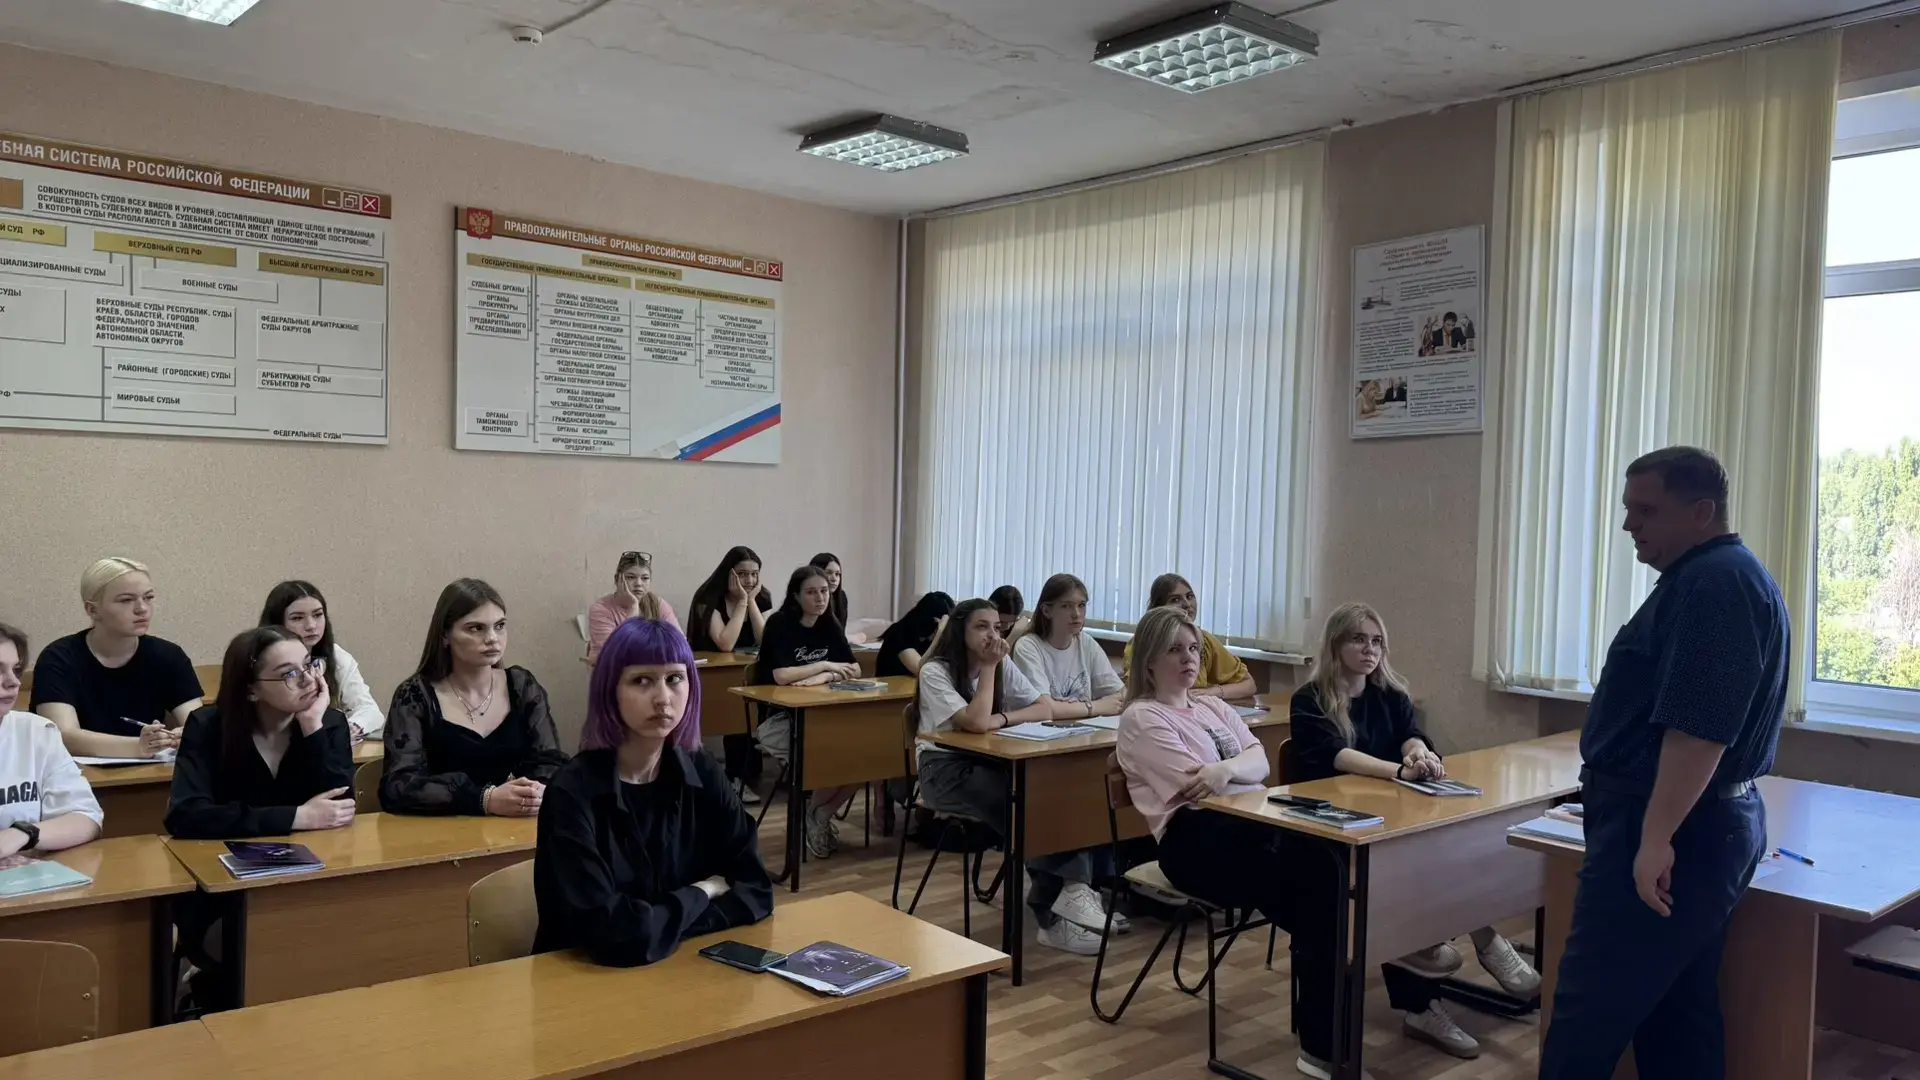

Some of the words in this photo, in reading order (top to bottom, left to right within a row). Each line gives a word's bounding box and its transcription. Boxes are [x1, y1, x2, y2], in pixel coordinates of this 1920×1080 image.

[0, 140, 44, 159] БНАЯ
[50, 148, 121, 170] СИСТЕМА
[127, 160, 223, 187] РОССИЙСКОЙ
[229, 176, 310, 200] ФЕДЕРАЦИИ
[37, 185, 99, 200] СОВОКУПНОСТЬ
[101, 194, 126, 204] СУДОВ
[128, 198, 147, 207] ВСЕХ
[148, 201, 173, 211] ВИДОВ
[175, 204, 180, 212] И
[217, 211, 274, 225] СОСТАВЛЯЮЩАЯ
[277, 220, 303, 230] ЕДИНОЕ
[304, 223, 325, 233] ЦЕЛОЕ
[333, 227, 375, 239] ПРИЗВАННАЯ
[37, 194, 99, 209] ОСУЩЕСТВЛЯТЬ
[101, 203, 142, 215] СУДЕБНУЮ
[175, 213, 212, 225] СУДЕБНАЯ
[214, 218, 246, 229] СИСТЕМА
[247, 223, 270, 232] ИМЕЕТ
[273, 227, 327, 240] ИЕРАРХИЧЕСКОЕ
[38, 202, 43, 210] В
[45, 203, 82, 214] КОТОРОЙ
[83, 209, 106, 218] СУДЫ
[107, 212, 170, 227] РАСПОЛАГАЮТСЯ
[179, 222, 231, 235] ЗАВИСИМОСТИ
[235, 229, 243, 237] ОТ
[245, 230, 268, 240] СВОИХ
[271, 234, 318, 246] ПОЛНОМОЧИЙ
[7, 225, 23, 234] СУД
[33, 228, 45, 236] РФ
[128, 240, 173, 252] ВЕРХОВНЫЙ
[504, 220, 607, 246] ПРАВООХРАНИТЕЛЬНЫЕ
[610, 238, 643, 252] ОРГАНЫ
[645, 244, 696, 261] РОССИЙСКОЙ
[698, 253, 741, 269] ФЕДЕРАЦИИ
[84, 267, 106, 276] СУДЫ
[269, 258, 299, 269] ВЫСШИЙ
[300, 263, 350, 274] АРБИТРАЖНЫЙ
[351, 268, 363, 276] СУД
[481, 257, 534, 271] ГОСУДАРСТВЕННЫЕ
[597, 275, 618, 284] ОРГАНЫ
[589, 258, 648, 273] ПРАВООХРАНИТЕЛЬНЫЕ
[648, 268, 668, 276] ОРГАНЫ
[182, 279, 216, 289] ВОЕННЫЕ
[218, 282, 238, 291] СУДЫ
[471, 280, 501, 290] СУДЕБНЫЕ
[502, 284, 524, 293] ОРГАНЫ
[486, 294, 509, 303] ОРГАНЫ
[557, 292, 578, 300] ОРГАНЫ
[580, 295, 618, 305] ФЕДЕРАЛЬНОЙ
[96, 298, 141, 308] ВЕРХОВНЫЕ
[143, 303, 164, 311] СУДЫ
[212, 310, 232, 318] СУДЫ
[478, 300, 518, 311] ПРОКУРАТУРЫ
[555, 298, 579, 306] СЛУЖБЫ
[579, 302, 619, 312] БЕЗОПАСНОСТИ
[645, 304, 684, 315] ОБЩЕСТВЕННЫЕ
[166, 313, 199, 323] ГОРОДОВ
[486, 311, 509, 320] ОРГАНЫ
[554, 308, 575, 316] ОРГАНЫ
[576, 310, 609, 320] ВНУТРЕННИХ
[648, 311, 682, 320] ОРГАНИЗАЦИИ
[718, 314, 738, 322] ЧАСТНЫЕ
[95, 315, 155, 327] ФЕДЕРАЛЬНОГО
[261, 315, 310, 326] ФЕДЕРАЛЬНЫЕ
[311, 320, 359, 331] АРБИТРАЖНЫЕ
[469, 316, 526, 329] ПРЕДВАРИТЕЛЬНОГО
[549, 319, 571, 327] ОРГАНЫ
[572, 321, 597, 330] ВНЕШНЕЙ
[598, 325, 623, 333] РАЗВЕДКИ
[650, 320, 680, 329] АДВОКАТУРА
[724, 321, 757, 330] ОРГАНИЗАЦИИ
[95, 323, 148, 335] АВТОНОМНОЙ
[261, 323, 280, 331] СУДЫ
[282, 325, 311, 334] ОКРУГОВ
[474, 324, 521, 335] РАССЛЕДОВАНИЯ
[714, 328, 746, 337] ПРЕДПРИЯТИЯ
[746, 332, 767, 340] ЧАСТНОЙ
[95, 332, 149, 343] АВТОНОМНЫХ
[151, 337, 184, 346] ОКРУГОВ
[556, 331, 595, 341] ФЕДЕРАЛЬНЫЕ
[596, 336, 616, 344] ОРГАНЫ
[640, 330, 667, 339] КОМИССИИ
[551, 337, 601, 349] ГОСУДАРСТВЕННОЙ
[602, 343, 623, 351] ОХРАНЫ
[637, 336, 694, 348] НЕСОВЕРШЕННОЛЕТНИХ
[735, 337, 769, 346] ДЕЯТЕЛЬНОСТИ
[643, 346, 687, 356] НАБЛЮДАТЕЛЬНЫЕ
[714, 343, 746, 352] ПРЕДПРИЯТИЯ
[549, 347, 571, 355] ОРГАНЫ
[571, 349, 603, 358] НАЛОГОВОЙ
[603, 353, 626, 361] СЛУЖБЫ
[652, 354, 678, 362] КОМИССИИ
[707, 348, 738, 357] ДЕТЕКТИВНОЙ
[739, 352, 772, 361] ДЕЯТЕЛЬНОСТИ
[556, 359, 595, 369] ФЕДЕРАЛЬНЫЕ
[596, 363, 617, 371] ОРГАНЫ
[724, 366, 756, 374] КООПЕРАТИВЫ
[117, 363, 158, 374] РАЙОННЫЕ
[162, 367, 209, 379] (ГОРОДСКИЕ)
[210, 371, 231, 379] СУДЫ
[558, 366, 590, 375] НАЛОГОВОЙ
[590, 369, 615, 377] ПОЛИЦИИ
[261, 371, 311, 382] АРБИТРАЖНЫЕ
[312, 375, 332, 383] СУДЫ
[544, 374, 566, 382] ОРГАНЫ
[567, 377, 605, 386] ПОГРАНИЧНОЙ
[605, 380, 627, 388] ОХРАНЫ
[261, 379, 299, 388] СУБЪЕКТОВ
[710, 379, 746, 388] НОТАРИАЛЬНЫЕ
[556, 387, 579, 395] СЛУЖБЫ
[580, 389, 615, 398] ЛИКВИДАЦИИ
[117, 393, 155, 403] МИРОВЫЕ
[156, 396, 180, 404] СУДЬИ
[550, 400, 594, 409] ЧРЕЗВЫЧАЙНЫХ
[485, 411, 509, 419] ОРГАНЫ
[562, 410, 606, 418] ФОРМИРОВАНИЯ
[476, 417, 519, 427] ТАМОЖЕННОГО
[552, 416, 590, 424] ГРАЖДАНСКОЙ
[273, 429, 322, 438] ФЕДЕРАЛЬНЫЕ
[323, 431, 341, 439] СУДЫ
[482, 425, 512, 433] КОНТРОЛЯ
[552, 437, 591, 445] ЮРИДИЧЕСКИЕ
